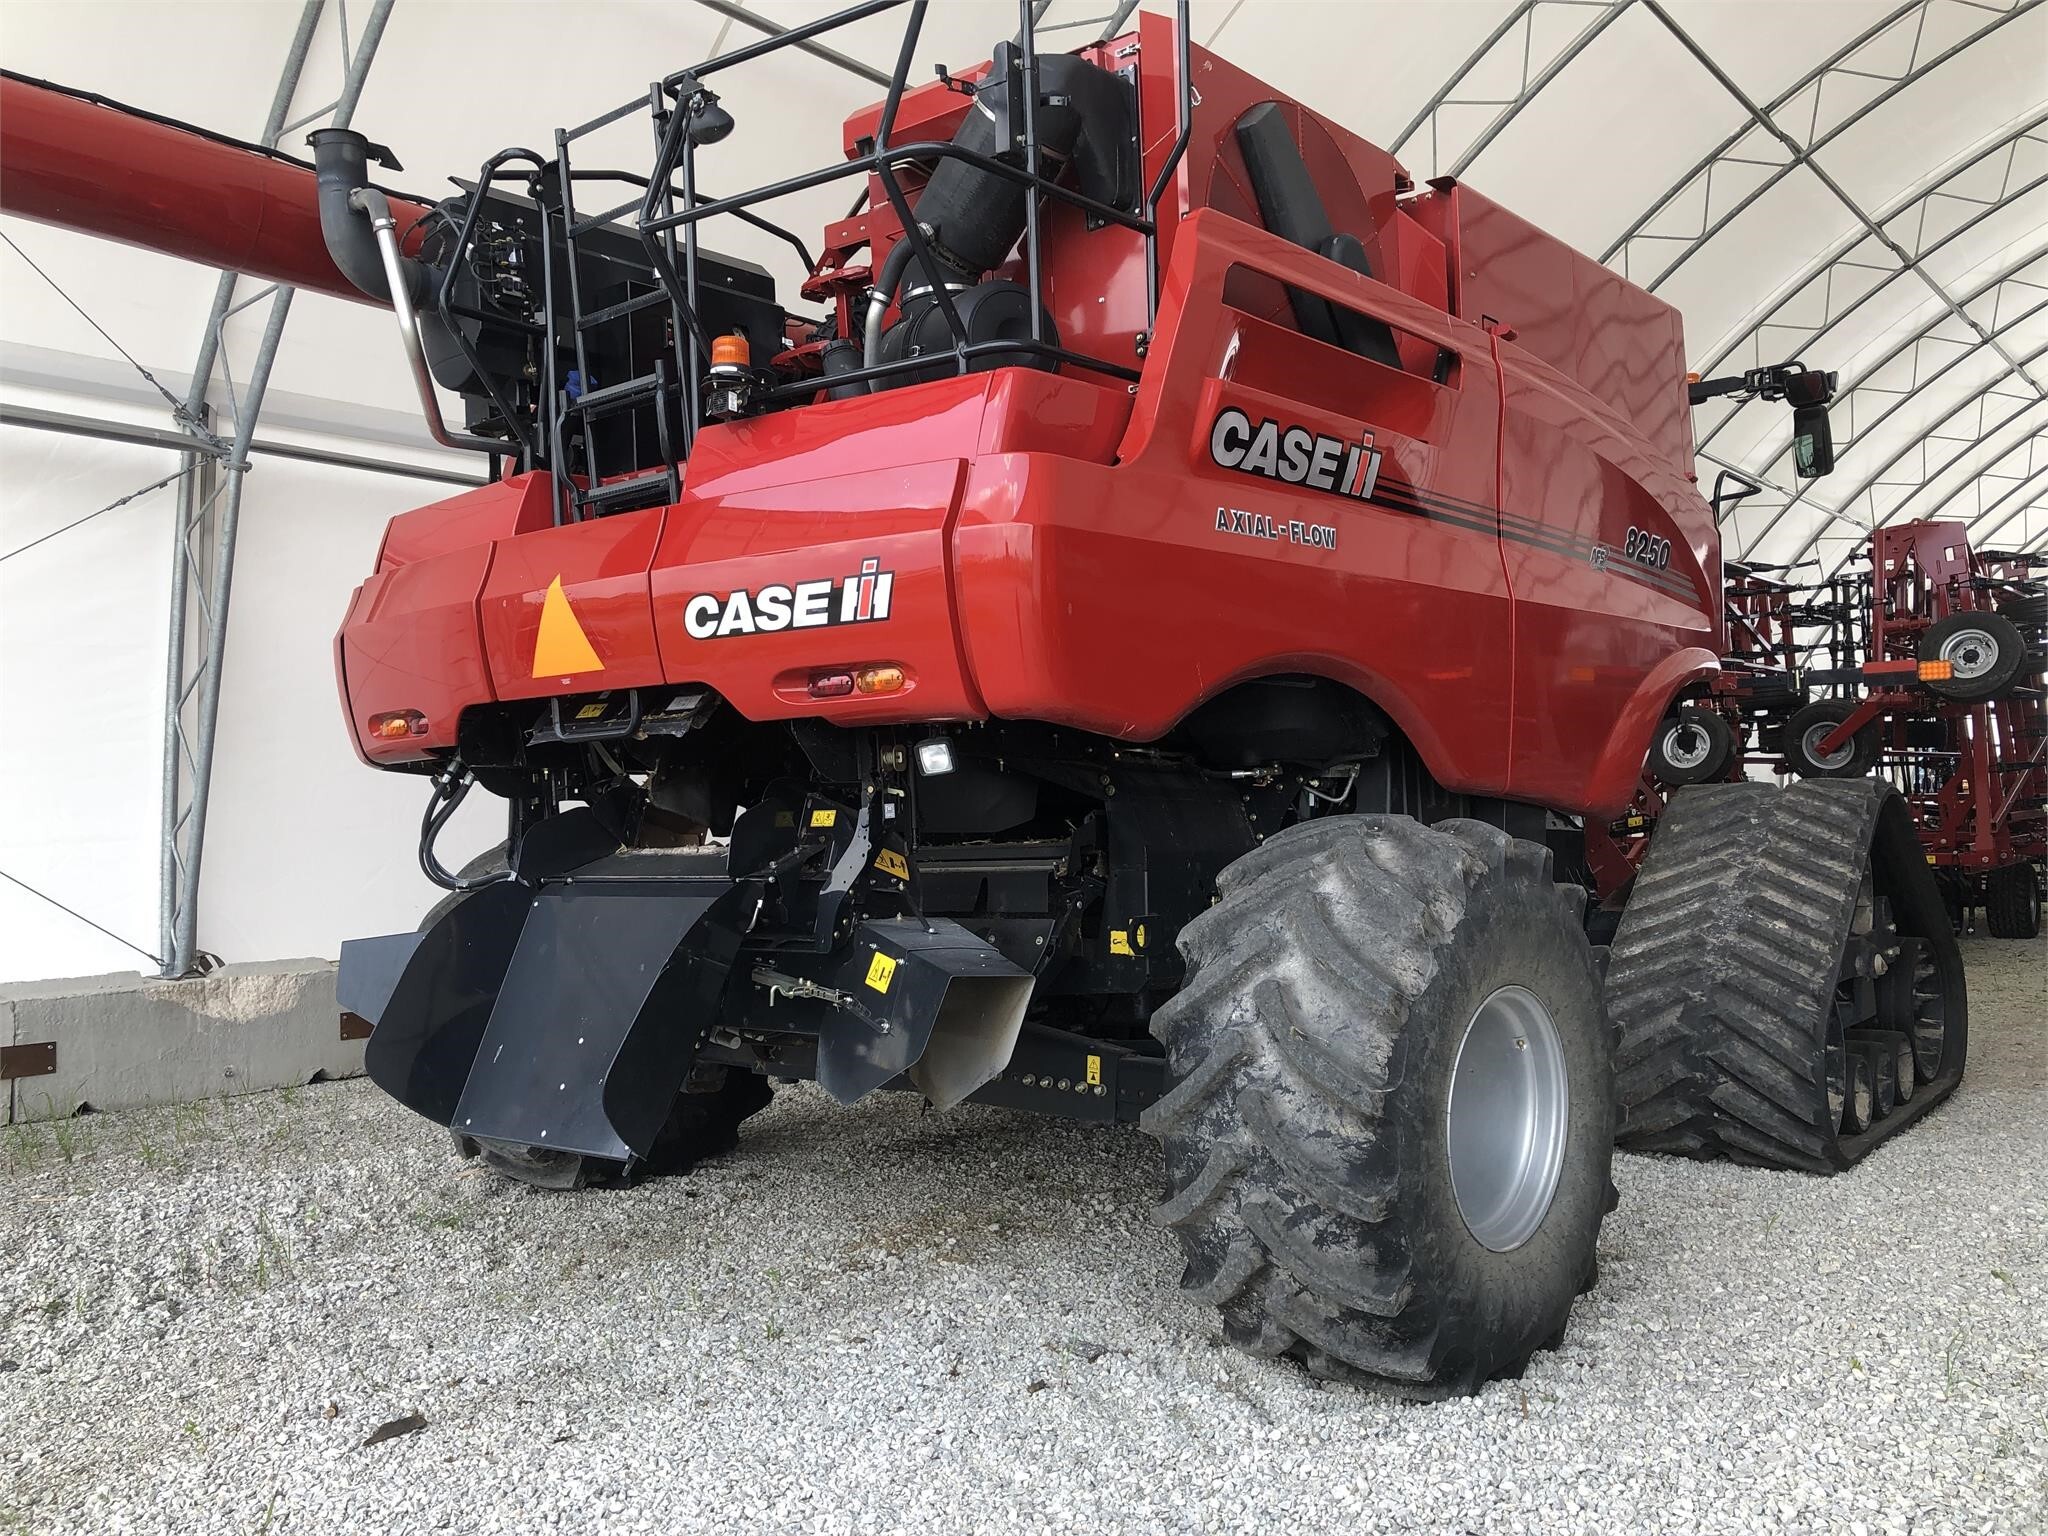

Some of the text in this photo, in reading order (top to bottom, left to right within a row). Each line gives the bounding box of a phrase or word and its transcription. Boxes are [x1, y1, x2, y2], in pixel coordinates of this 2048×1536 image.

[1211, 410, 1343, 491] CASE
[1215, 507, 1337, 550] AXIAL-FLOW
[1624, 525, 1672, 571] 8250
[684, 580, 832, 639] CASE
